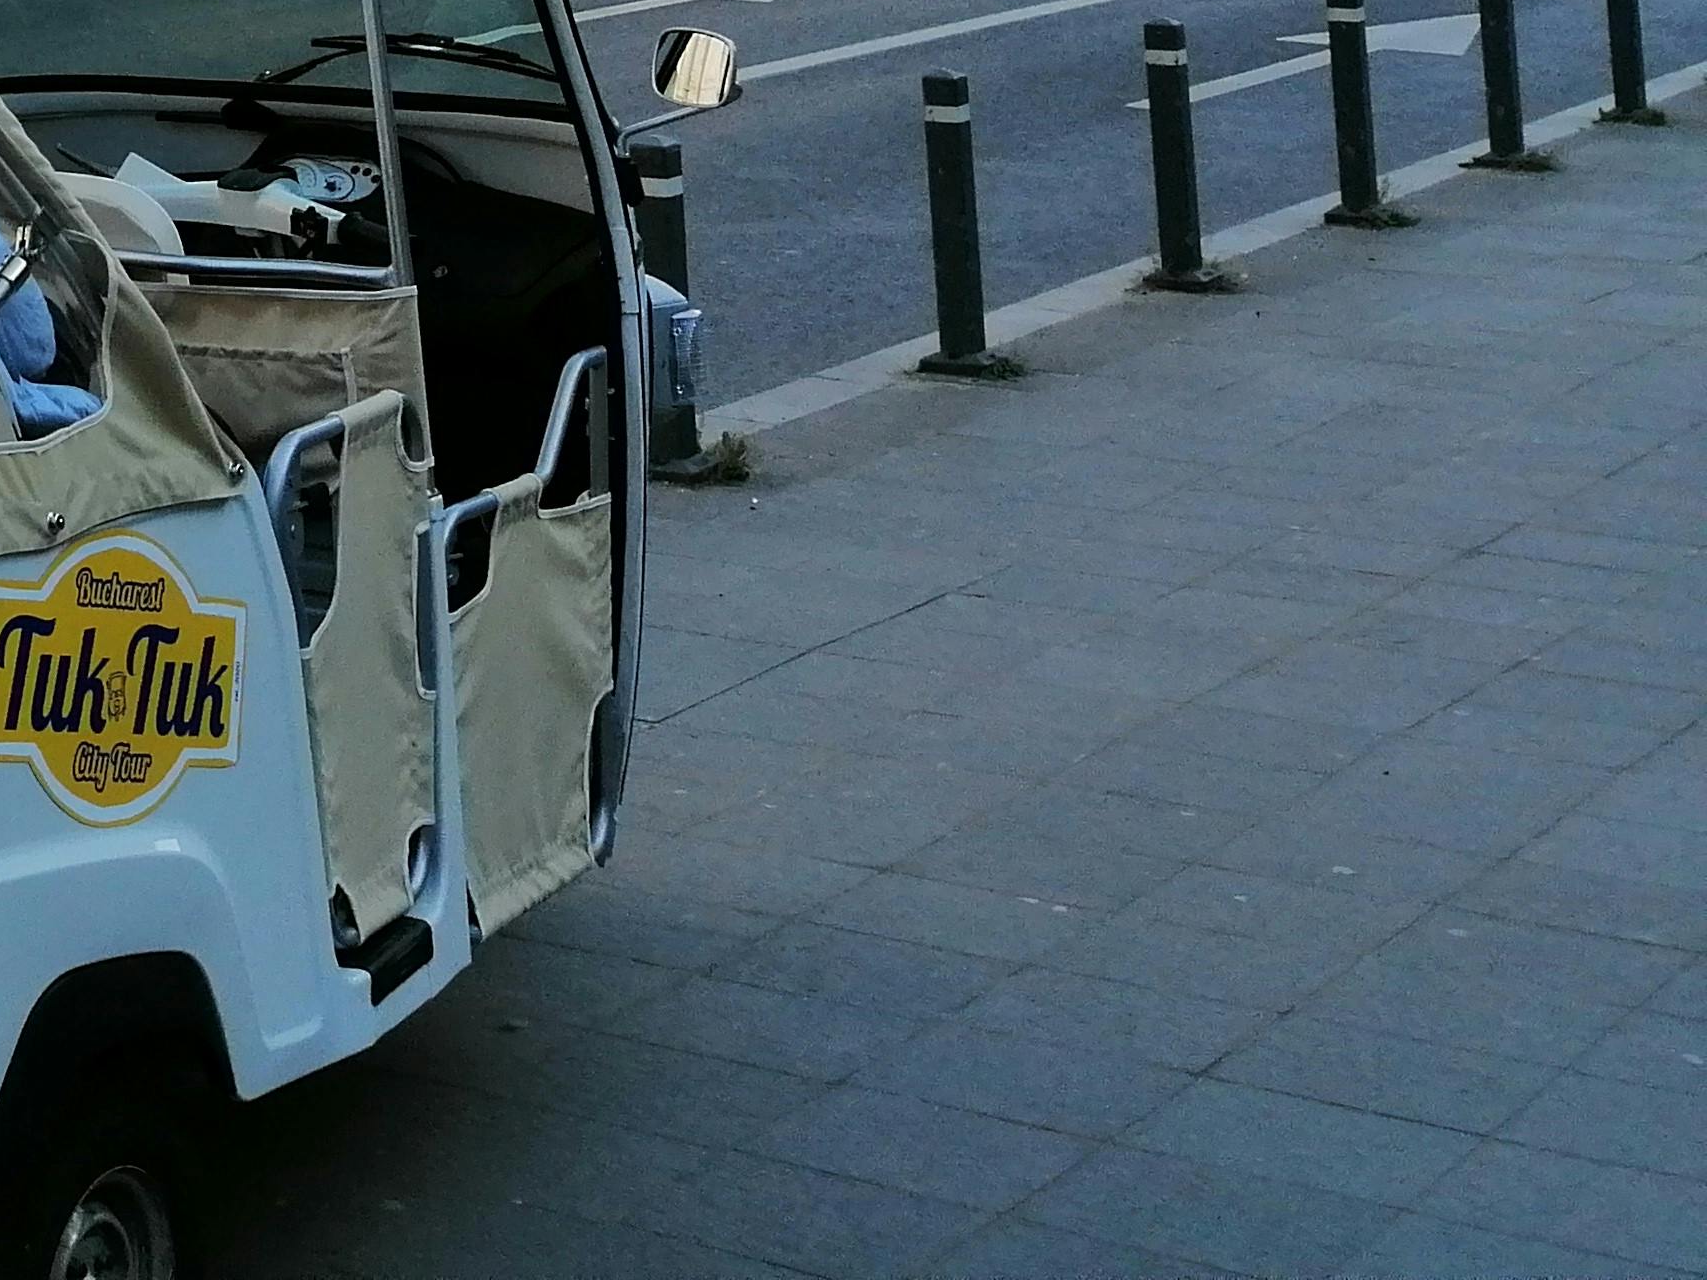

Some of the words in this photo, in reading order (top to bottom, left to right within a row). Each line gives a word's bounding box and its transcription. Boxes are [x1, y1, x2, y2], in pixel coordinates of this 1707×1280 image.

[75, 566, 165, 612] Bucharest
[126, 624, 229, 738] Tuk
[72, 741, 111, 793] City
[111, 742, 153, 783] Tour
